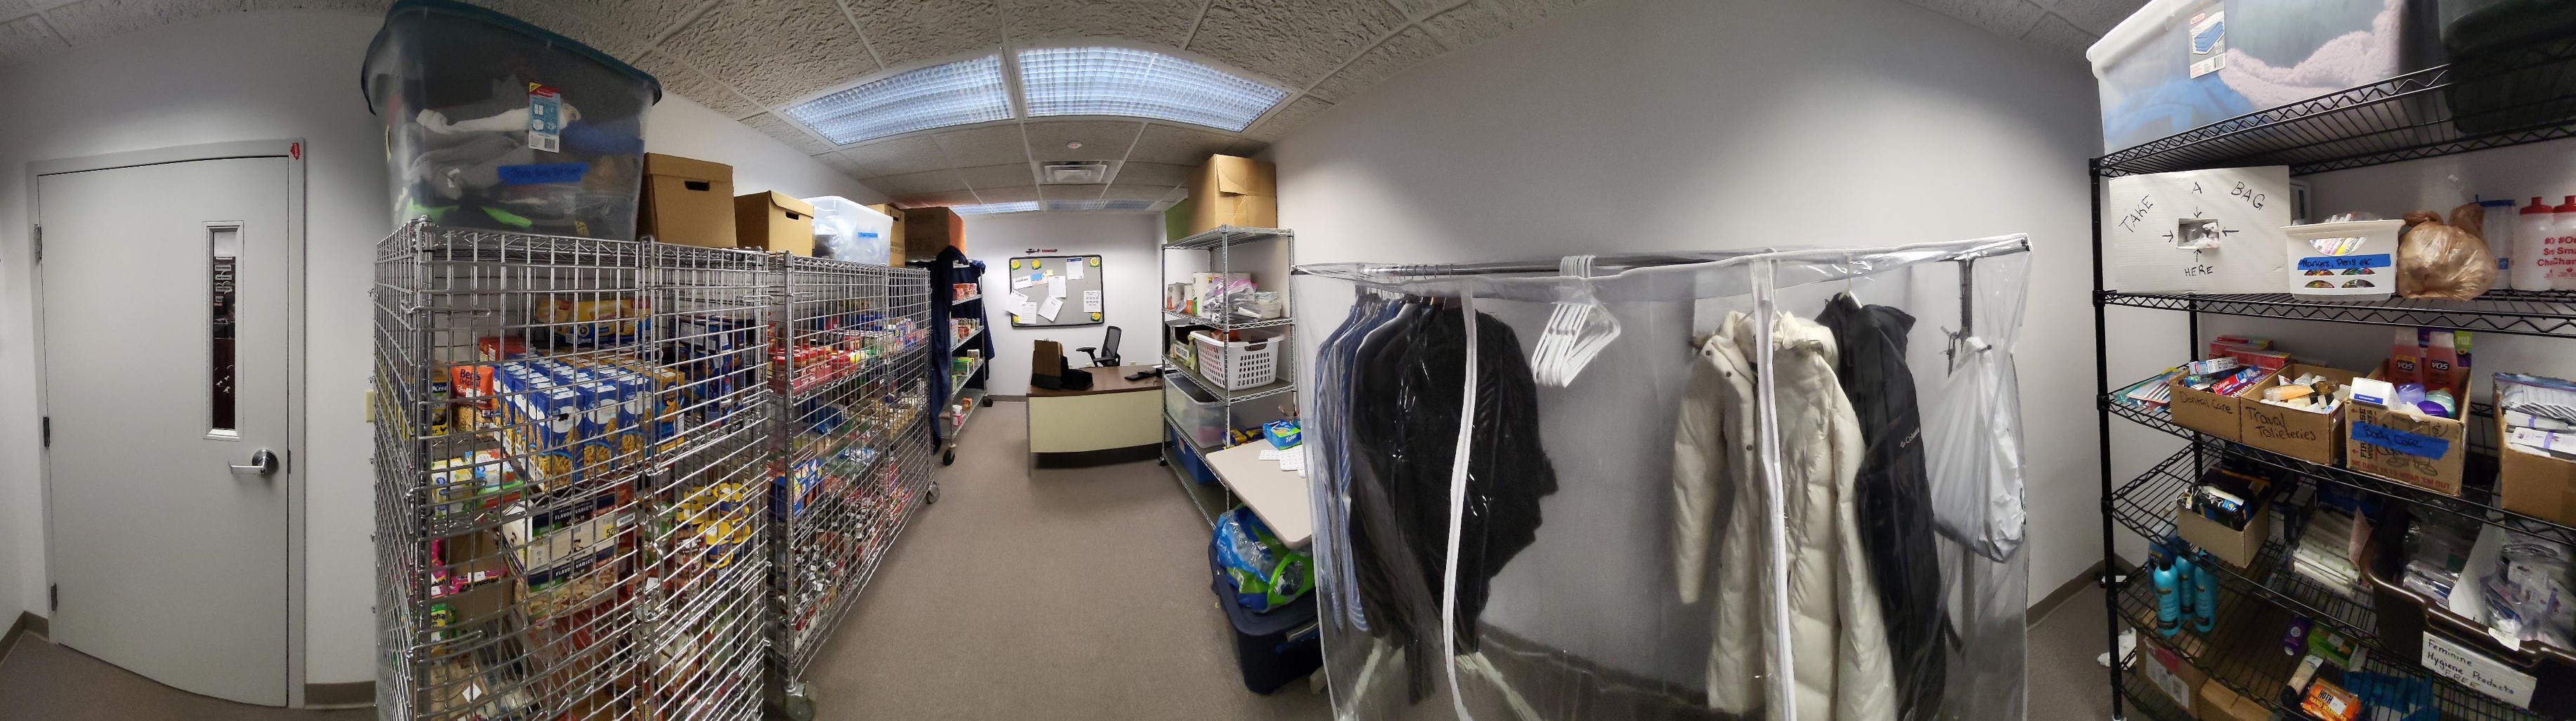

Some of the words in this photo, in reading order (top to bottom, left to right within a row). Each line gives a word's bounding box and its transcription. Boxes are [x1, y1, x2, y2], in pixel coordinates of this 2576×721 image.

[2119, 194, 2154, 233] TAKE
[2192, 181, 2202, 194] A
[2231, 181, 2265, 210] BAG
[2185, 265, 2213, 276] HERE
[2431, 361, 2449, 370] VO5
[2231, 383, 2252, 398] olgate
[2212, 398, 2233, 414] Care
[2363, 425, 2389, 443] Body
[2393, 434, 2423, 448] Care
[2362, 462, 2379, 472] DARE
[2400, 471, 2419, 482] WEAR
[2435, 479, 2452, 489] OUT
[554, 511, 572, 521] FLAVO
[575, 505, 594, 514] VARIET
[556, 567, 571, 576] FLAVO
[2428, 638, 2473, 667] Feminine
[2428, 651, 2464, 675] Hygiene
[2473, 671, 2514, 694] Products
[2445, 669, 2480, 689] FREE
[2318, 689, 2334, 704] HOTH
